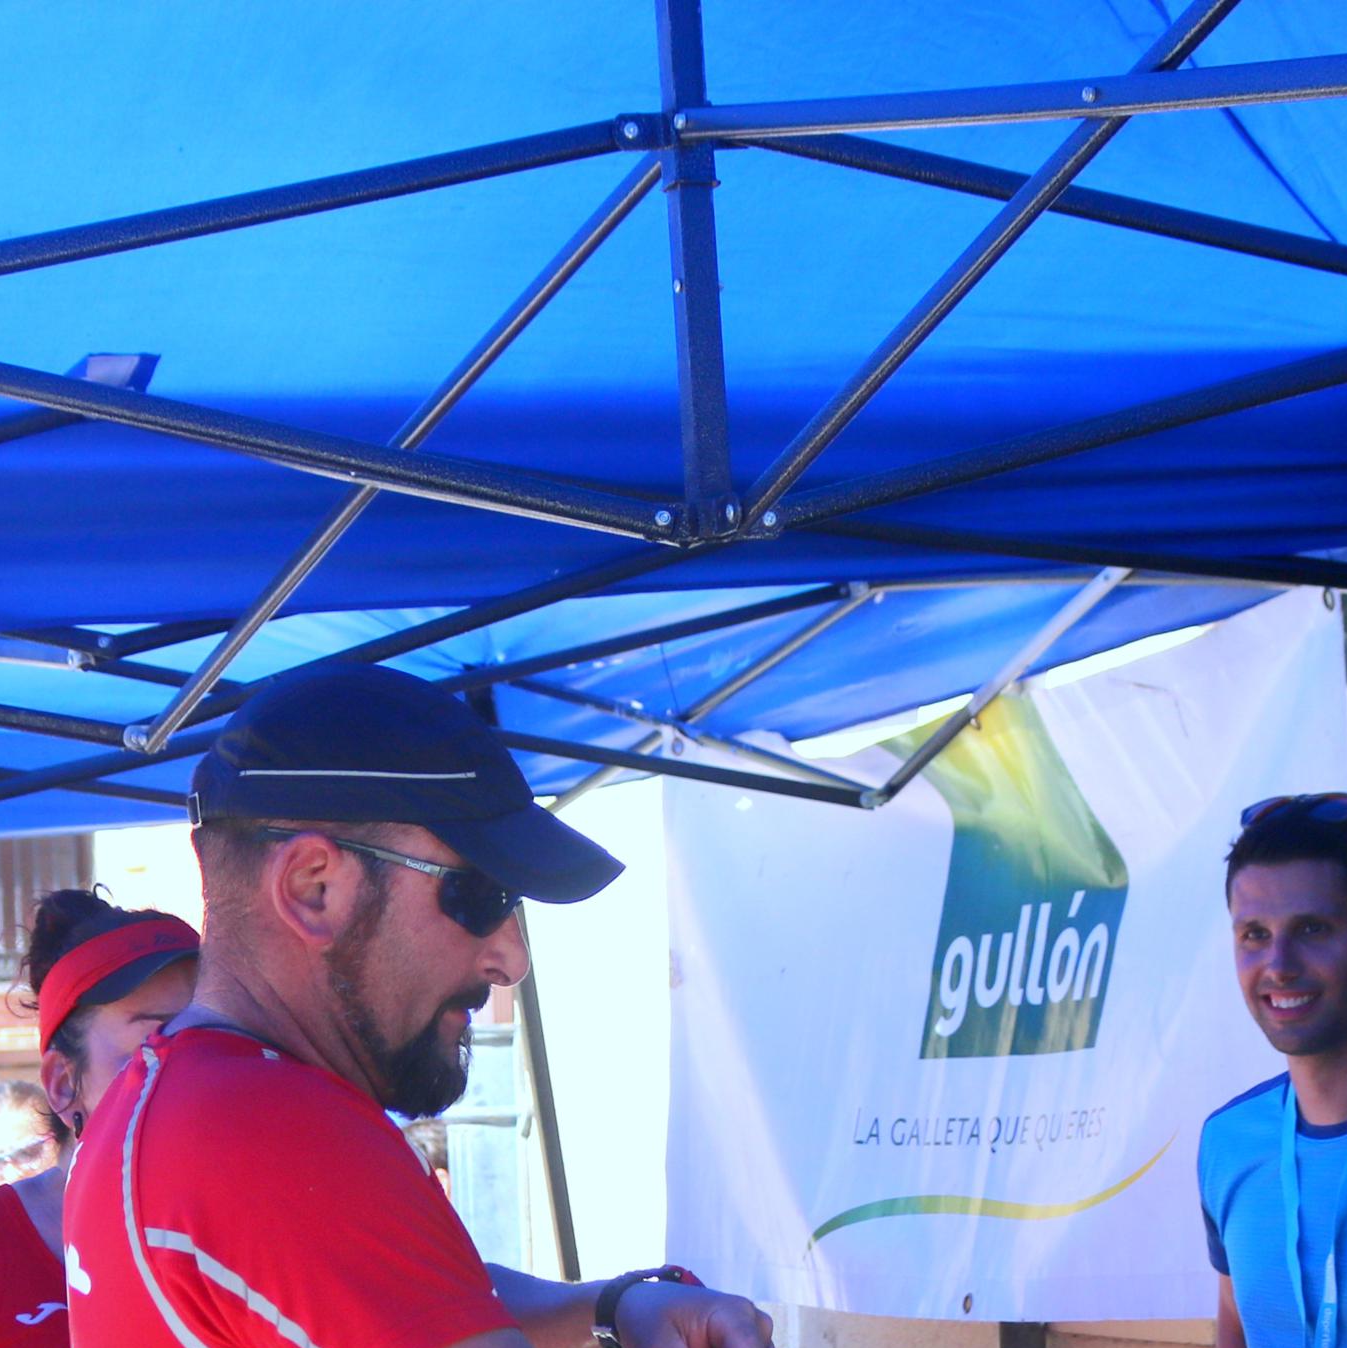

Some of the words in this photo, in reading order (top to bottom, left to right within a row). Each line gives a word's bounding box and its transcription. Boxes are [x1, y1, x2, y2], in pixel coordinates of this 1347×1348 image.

[935, 890, 1108, 1037] gullón
[853, 1108, 880, 1146] LA
[890, 1118, 981, 1146] GALLETA
[987, 1116, 1031, 1153] QUE
